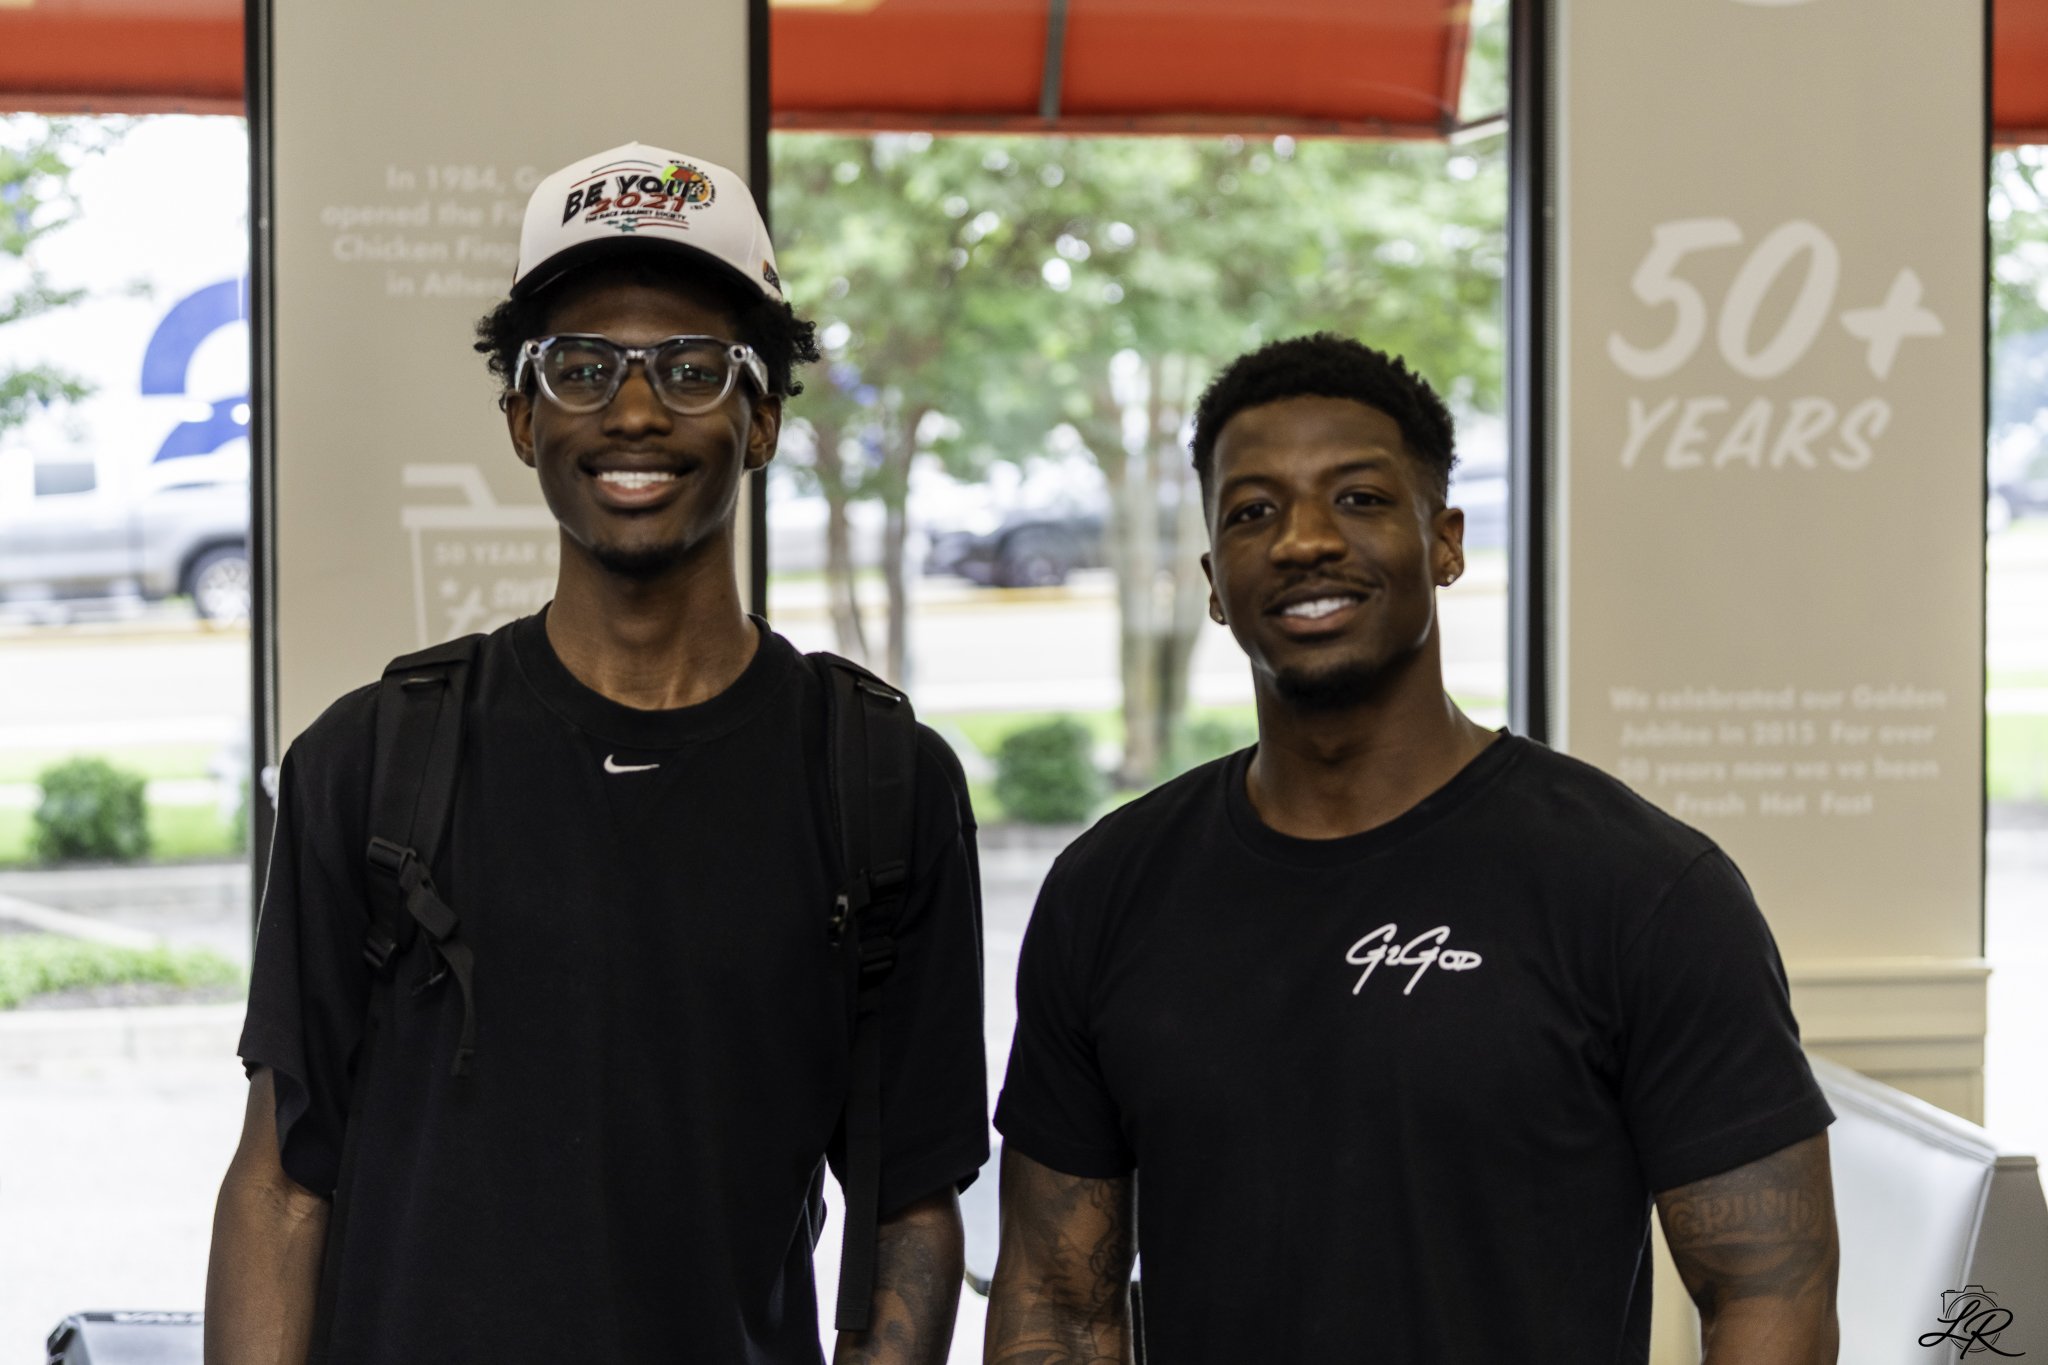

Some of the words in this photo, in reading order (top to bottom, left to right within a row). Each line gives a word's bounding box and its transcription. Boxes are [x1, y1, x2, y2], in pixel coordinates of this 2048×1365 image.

[385, 165, 415, 190] In
[562, 180, 606, 226] BE
[588, 192, 686, 215] 2021
[599, 210, 618, 220] RACE
[621, 209, 653, 217] AGAINST
[655, 211, 687, 220] SOCIETY
[321, 202, 430, 230] opened
[438, 202, 484, 226] the
[333, 235, 449, 260] Chicken
[386, 270, 415, 295] in
[1607, 217, 1946, 381] 50+
[1620, 397, 1892, 471] YEARS
[472, 543, 536, 565] YEAR
[1657, 685, 1796, 711] celebrated
[1852, 685, 1947, 711] Golden
